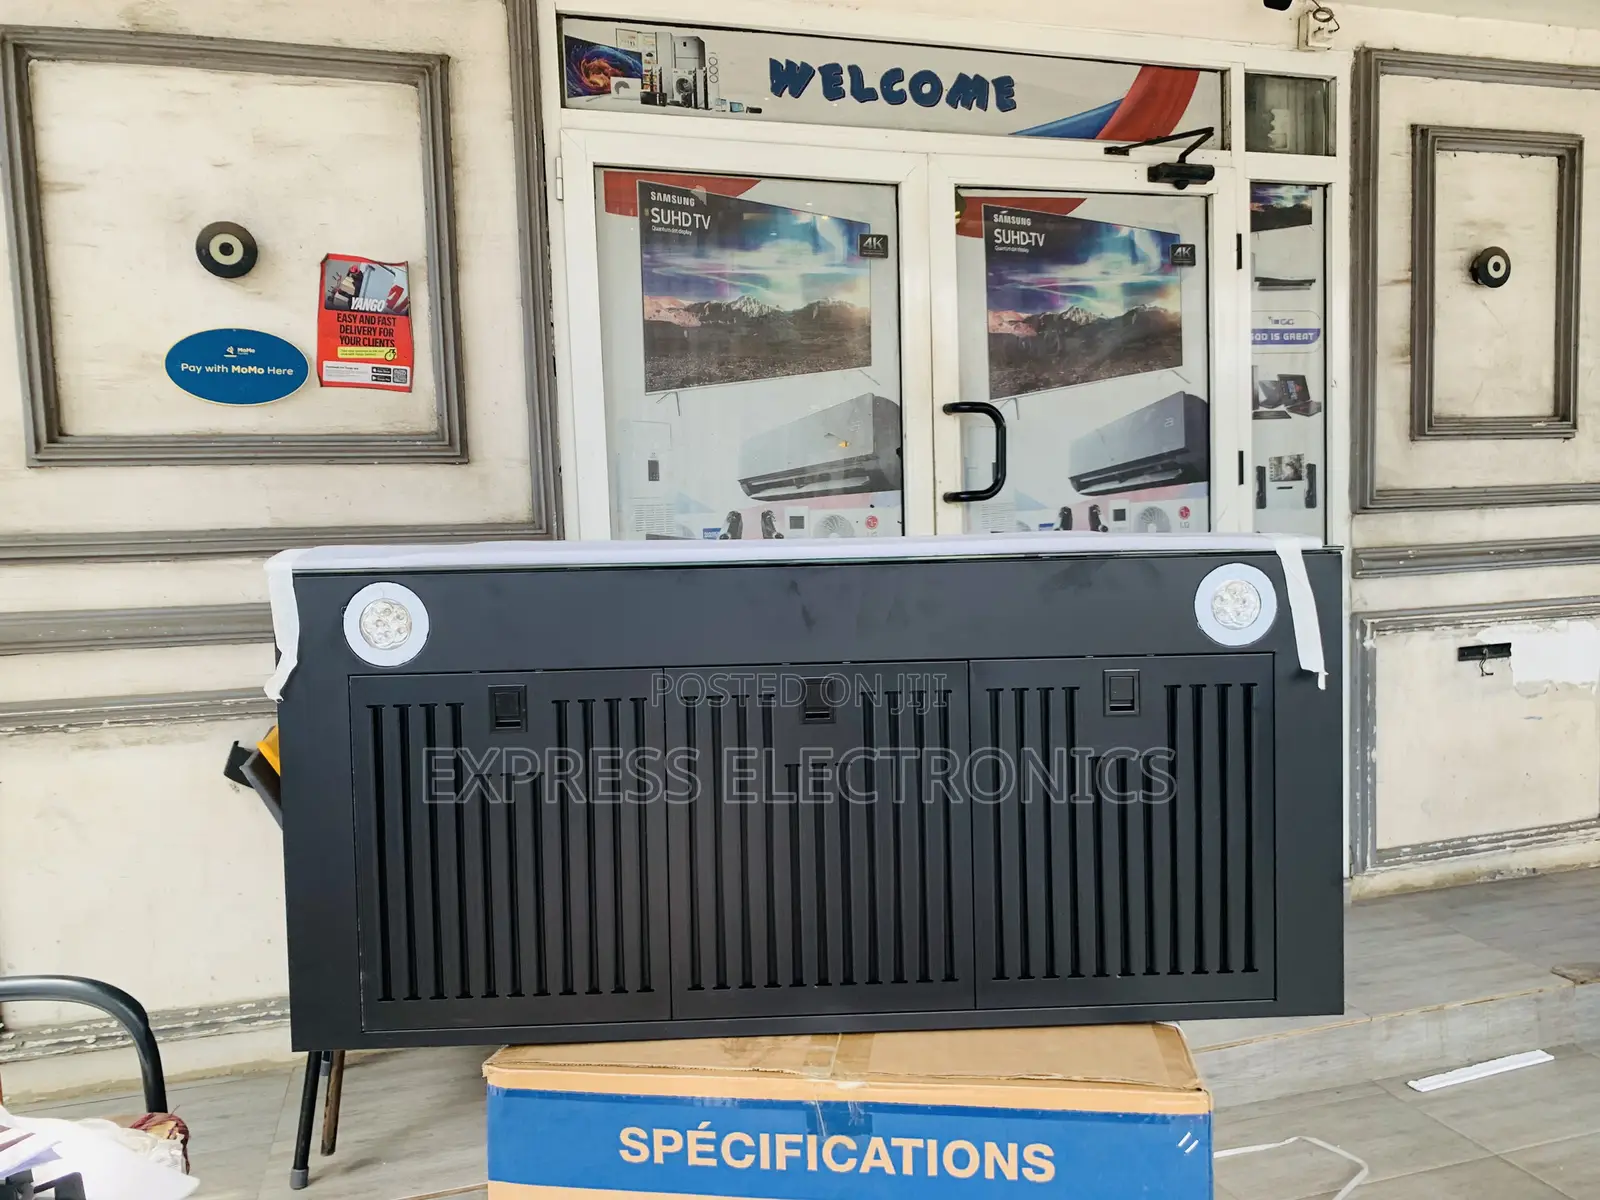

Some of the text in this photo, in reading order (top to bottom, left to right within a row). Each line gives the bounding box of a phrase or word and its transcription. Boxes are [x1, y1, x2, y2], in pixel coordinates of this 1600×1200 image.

[769, 58, 1017, 113] WELCOME
[650, 191, 695, 207] SAMSUNG
[650, 207, 711, 230] SUHD TV
[993, 213, 1032, 226] SAMSUNG
[863, 236, 884, 250] 4K
[350, 297, 386, 312] YANGO
[337, 313, 397, 326] EASY AND FAST
[340, 325, 394, 337] DELIVERY FOR
[1270, 332, 1281, 340] IS
[1282, 332, 1314, 341] GREAT
[339, 336, 396, 348] YOUR CLIENTS
[181, 363, 294, 376] Pay with MoMo Here
[618, 1121, 1056, 1183] SPÉCIFICATIONS
